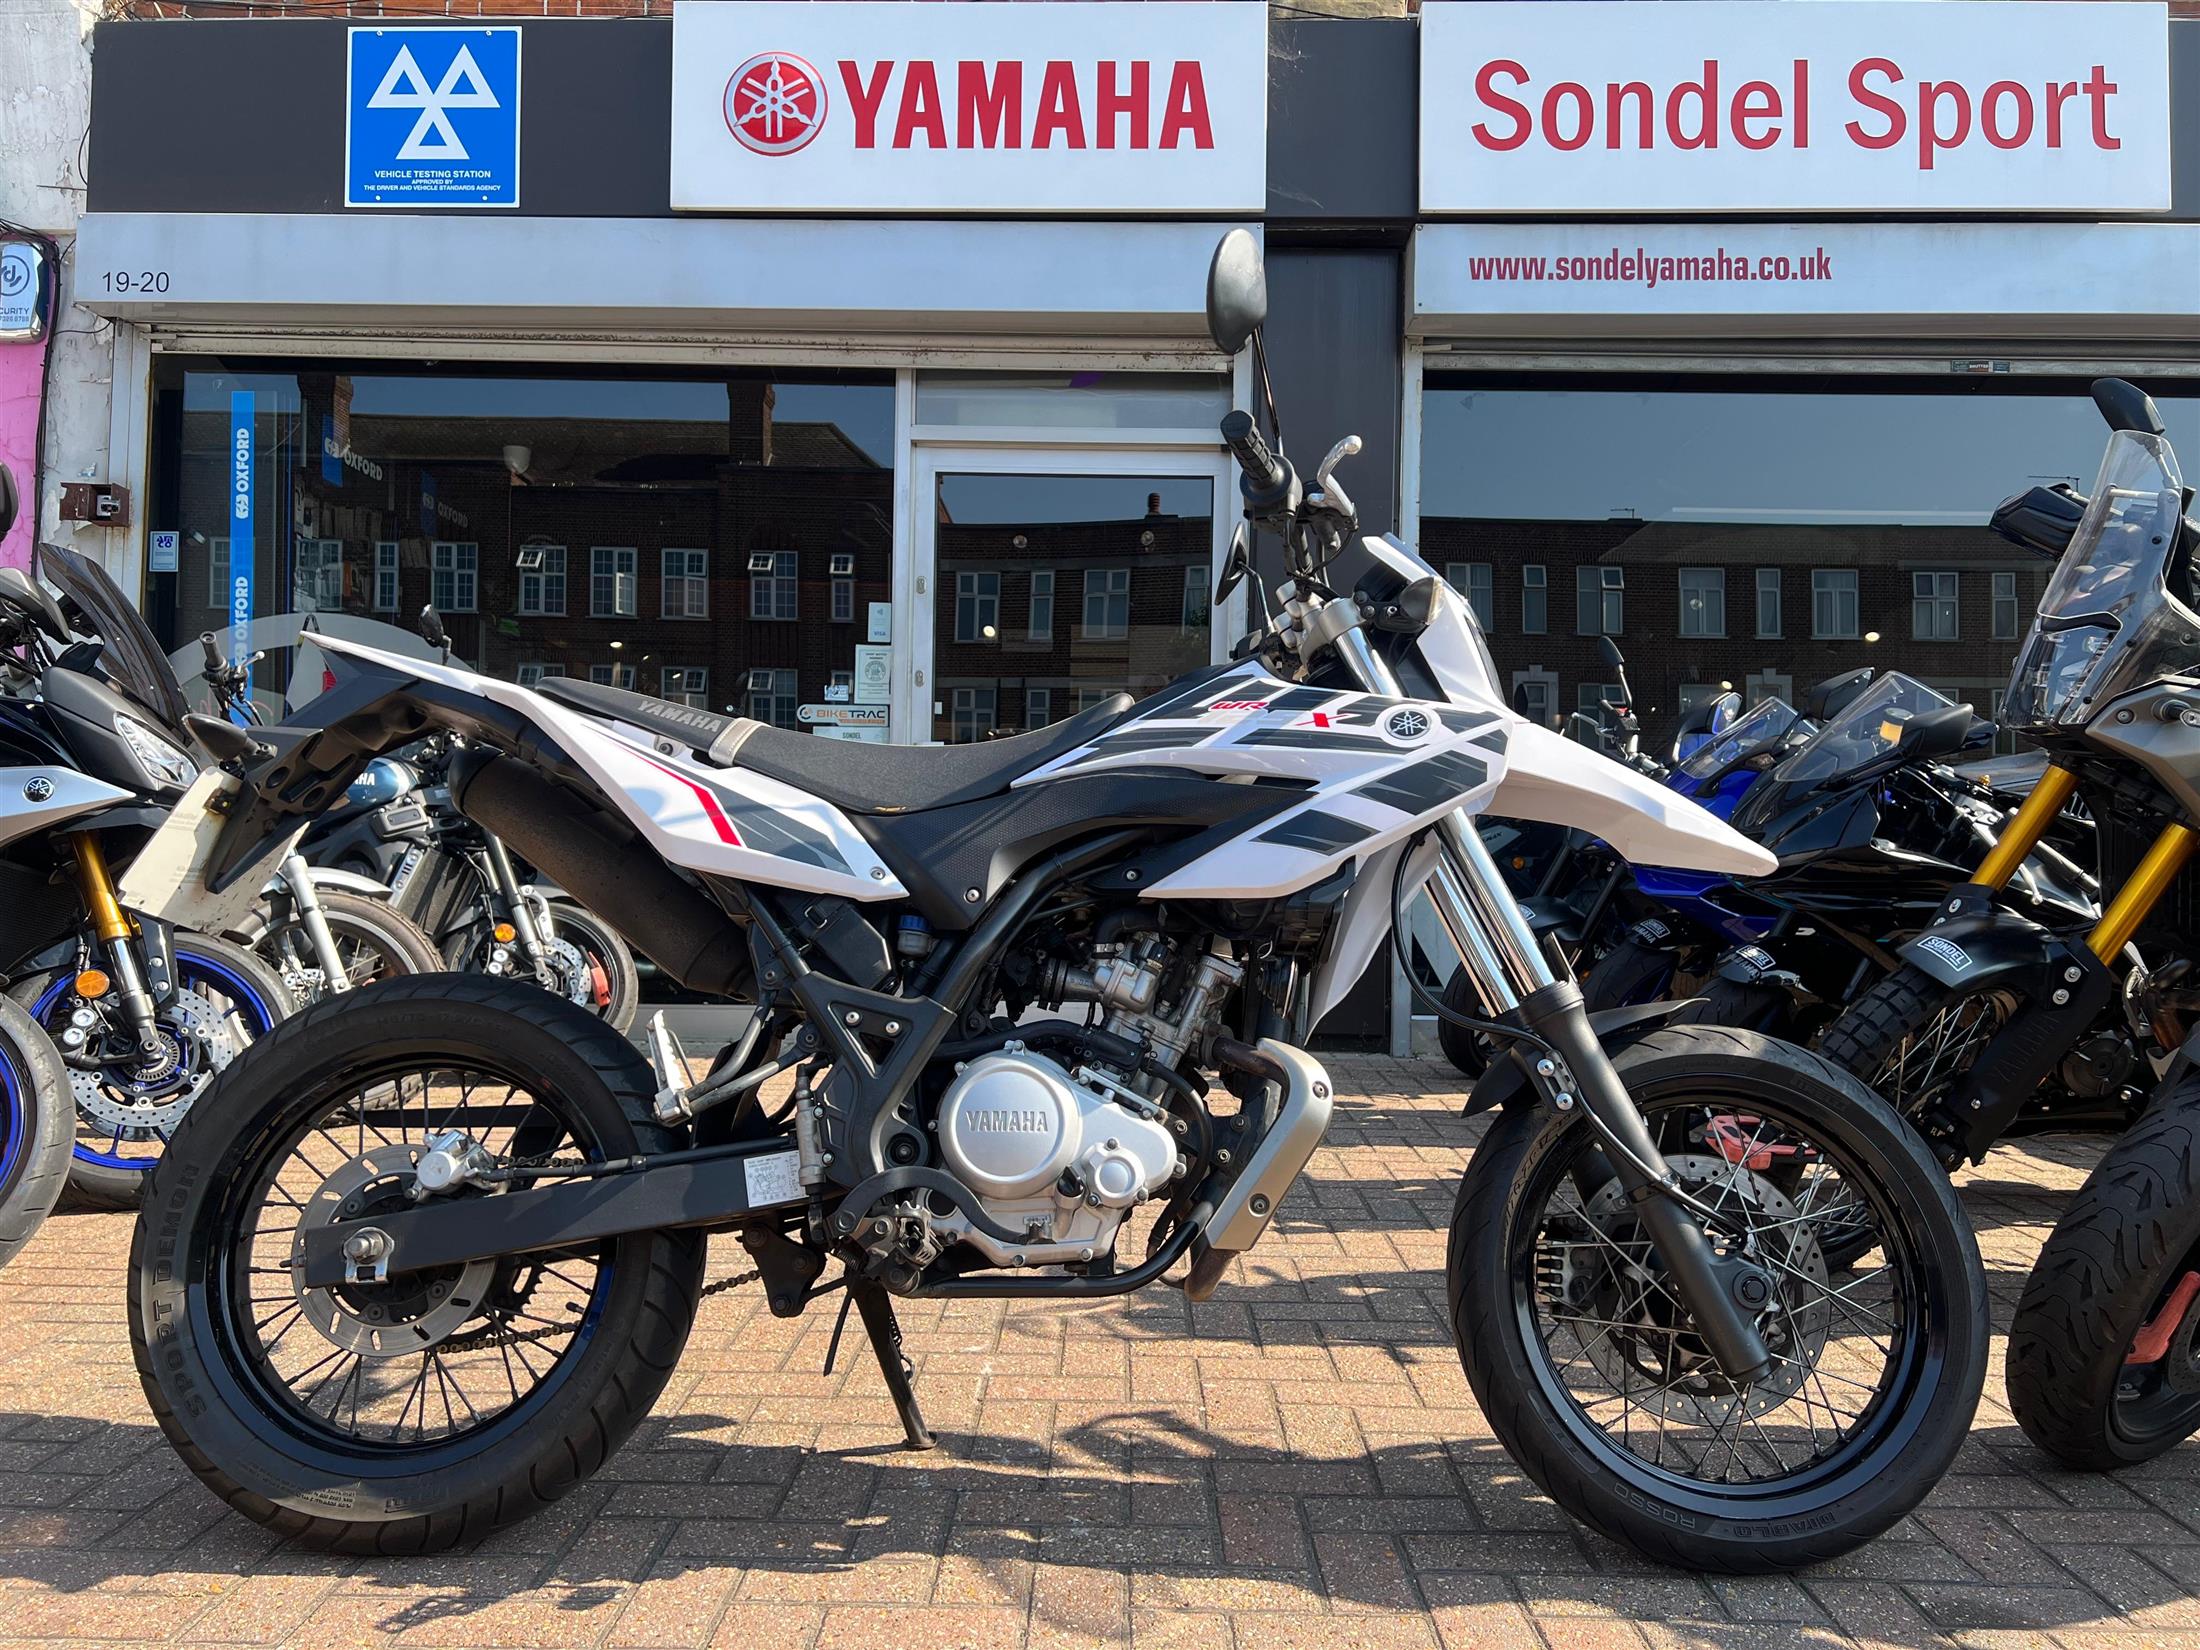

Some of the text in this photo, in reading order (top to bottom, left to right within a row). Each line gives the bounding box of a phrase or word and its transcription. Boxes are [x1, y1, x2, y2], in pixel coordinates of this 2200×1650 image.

[838, 60, 1214, 150] YAMAHA
[1471, 57, 2122, 170] Sondel Sport
[374, 170, 491, 178] VEHICLE TESTING STATION
[102, 271, 170, 293] 19-20
[1469, 247, 1832, 289] www.sondelyamaha.co.uk
[235, 427, 250, 493] OXFORD
[344, 450, 383, 482] OXFORD
[437, 502, 469, 529] OXFORD
[234, 576, 249, 641] OXFORD
[637, 700, 722, 733] YAMAHA
[816, 709, 886, 720] BIKETRAC
[1210, 701, 1270, 711] WR
[842, 731, 861, 739] SONDEL
[1927, 938, 1965, 964] SONDEL
[966, 1110, 1048, 1133] YAMAHA
[151, 1163, 207, 1420] SPORT DEMON
[1614, 1481, 1837, 1538] DIABLO ROSSO
